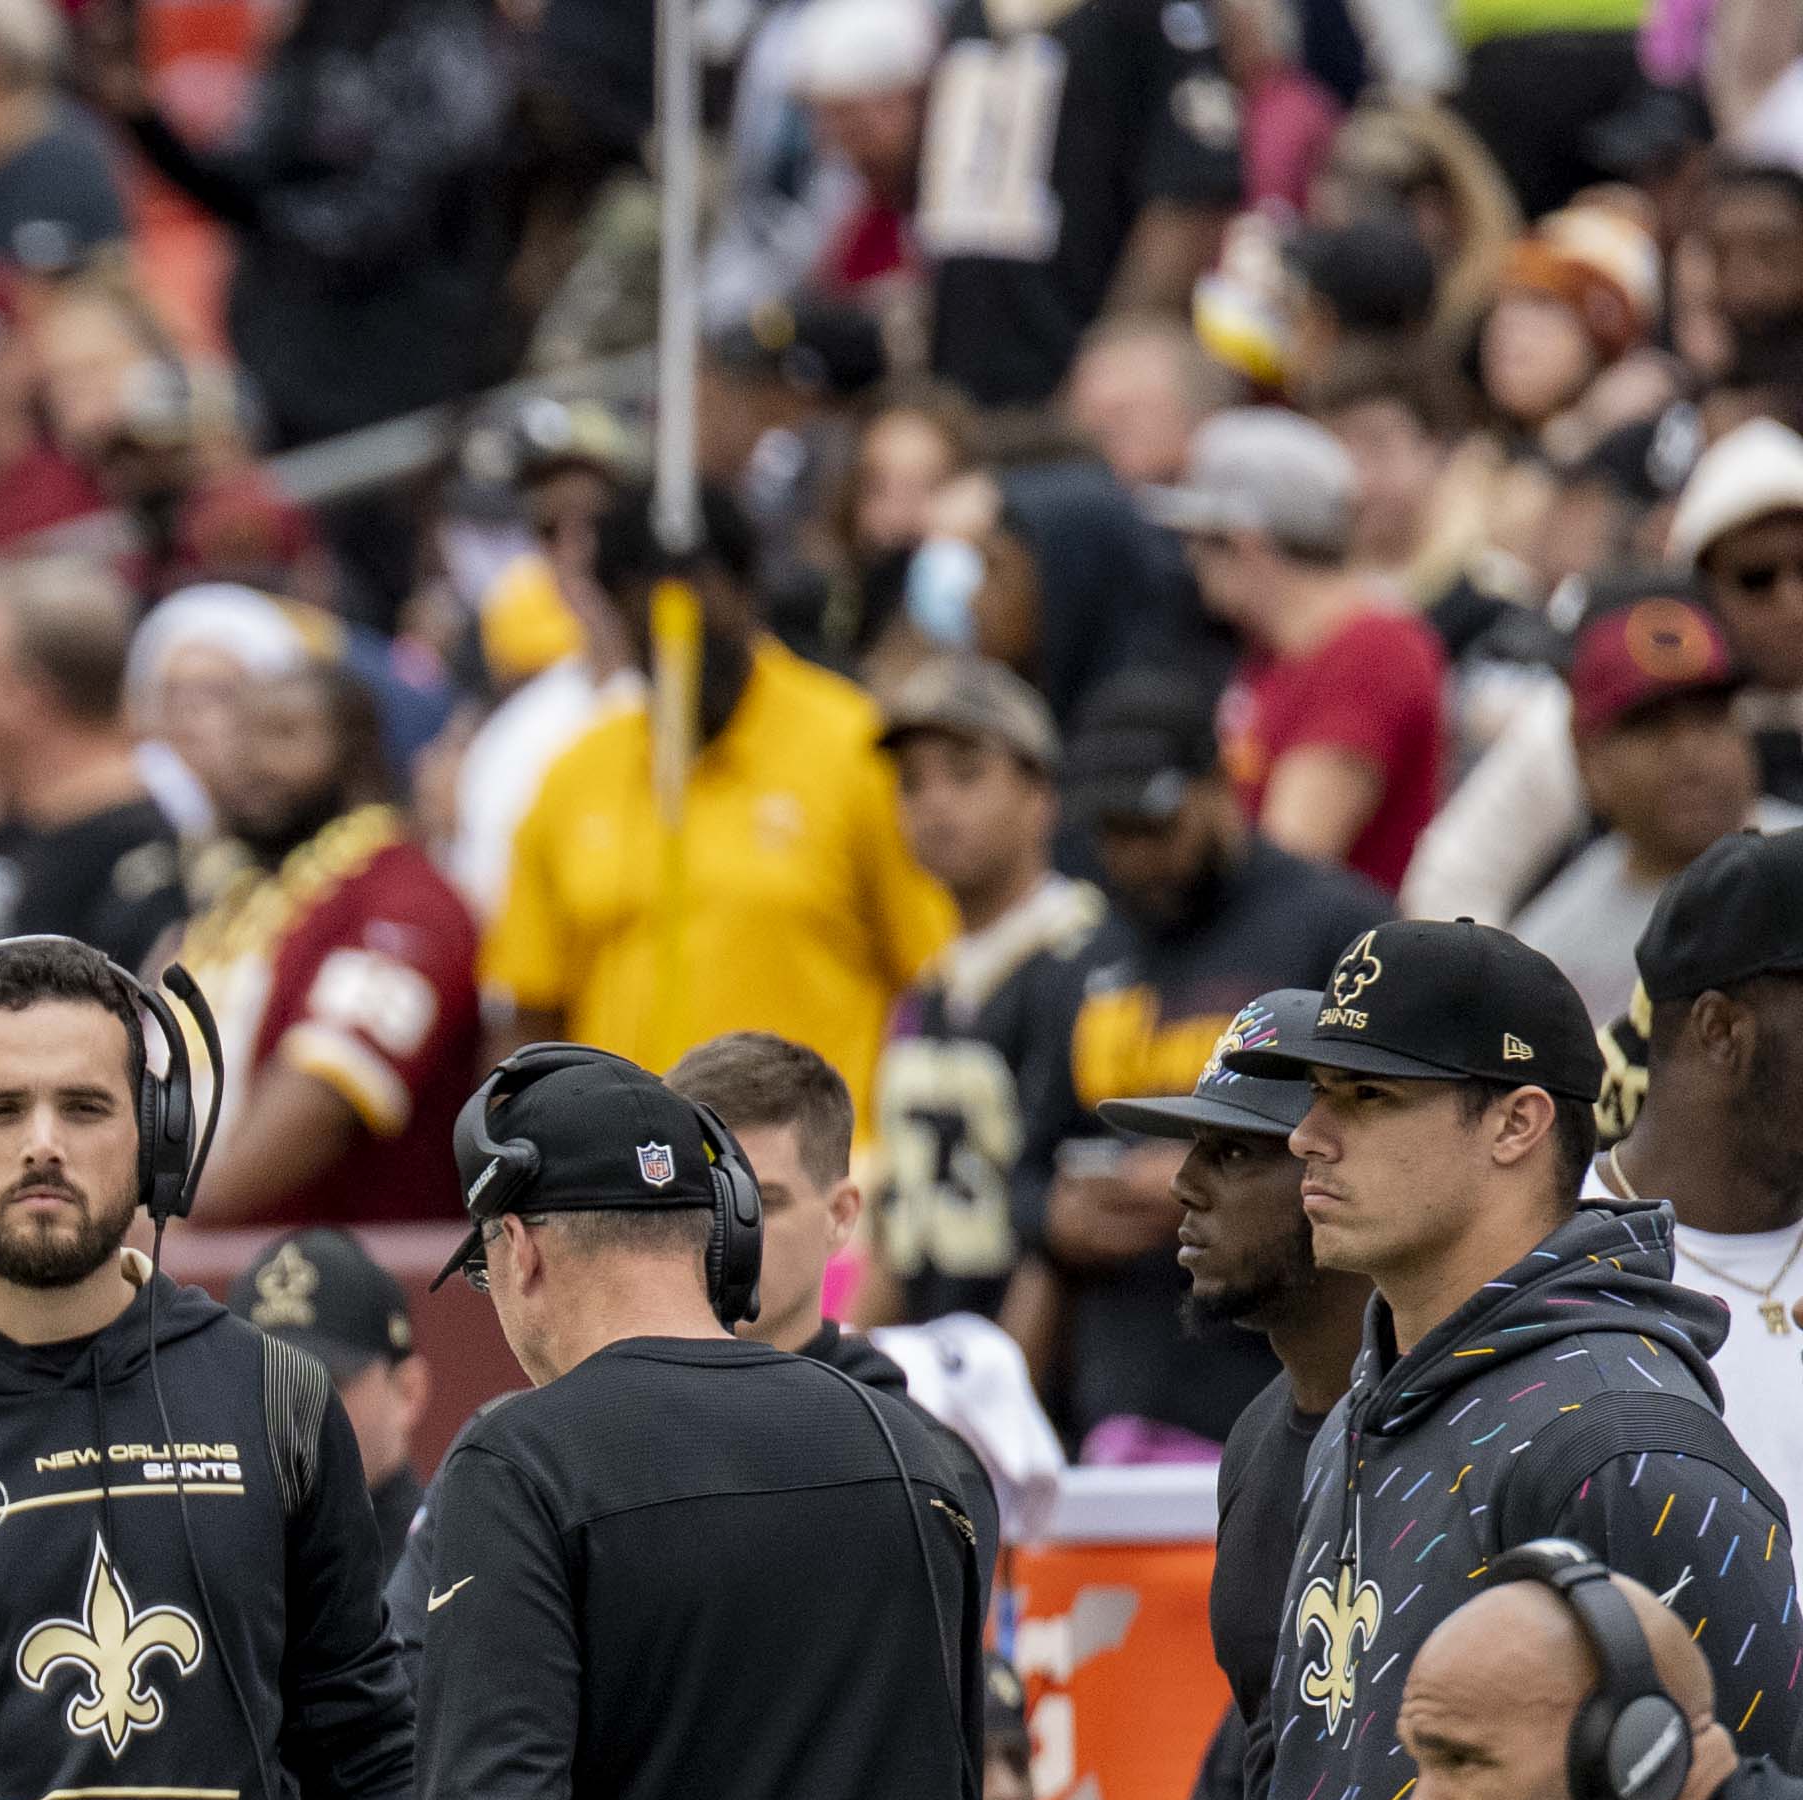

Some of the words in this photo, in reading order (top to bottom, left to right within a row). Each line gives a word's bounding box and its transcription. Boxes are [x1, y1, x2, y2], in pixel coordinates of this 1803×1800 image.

[467, 1156, 500, 1208] BOSE
[646, 1161, 668, 1178] NFL
[35, 1447, 101, 1473] NEW
